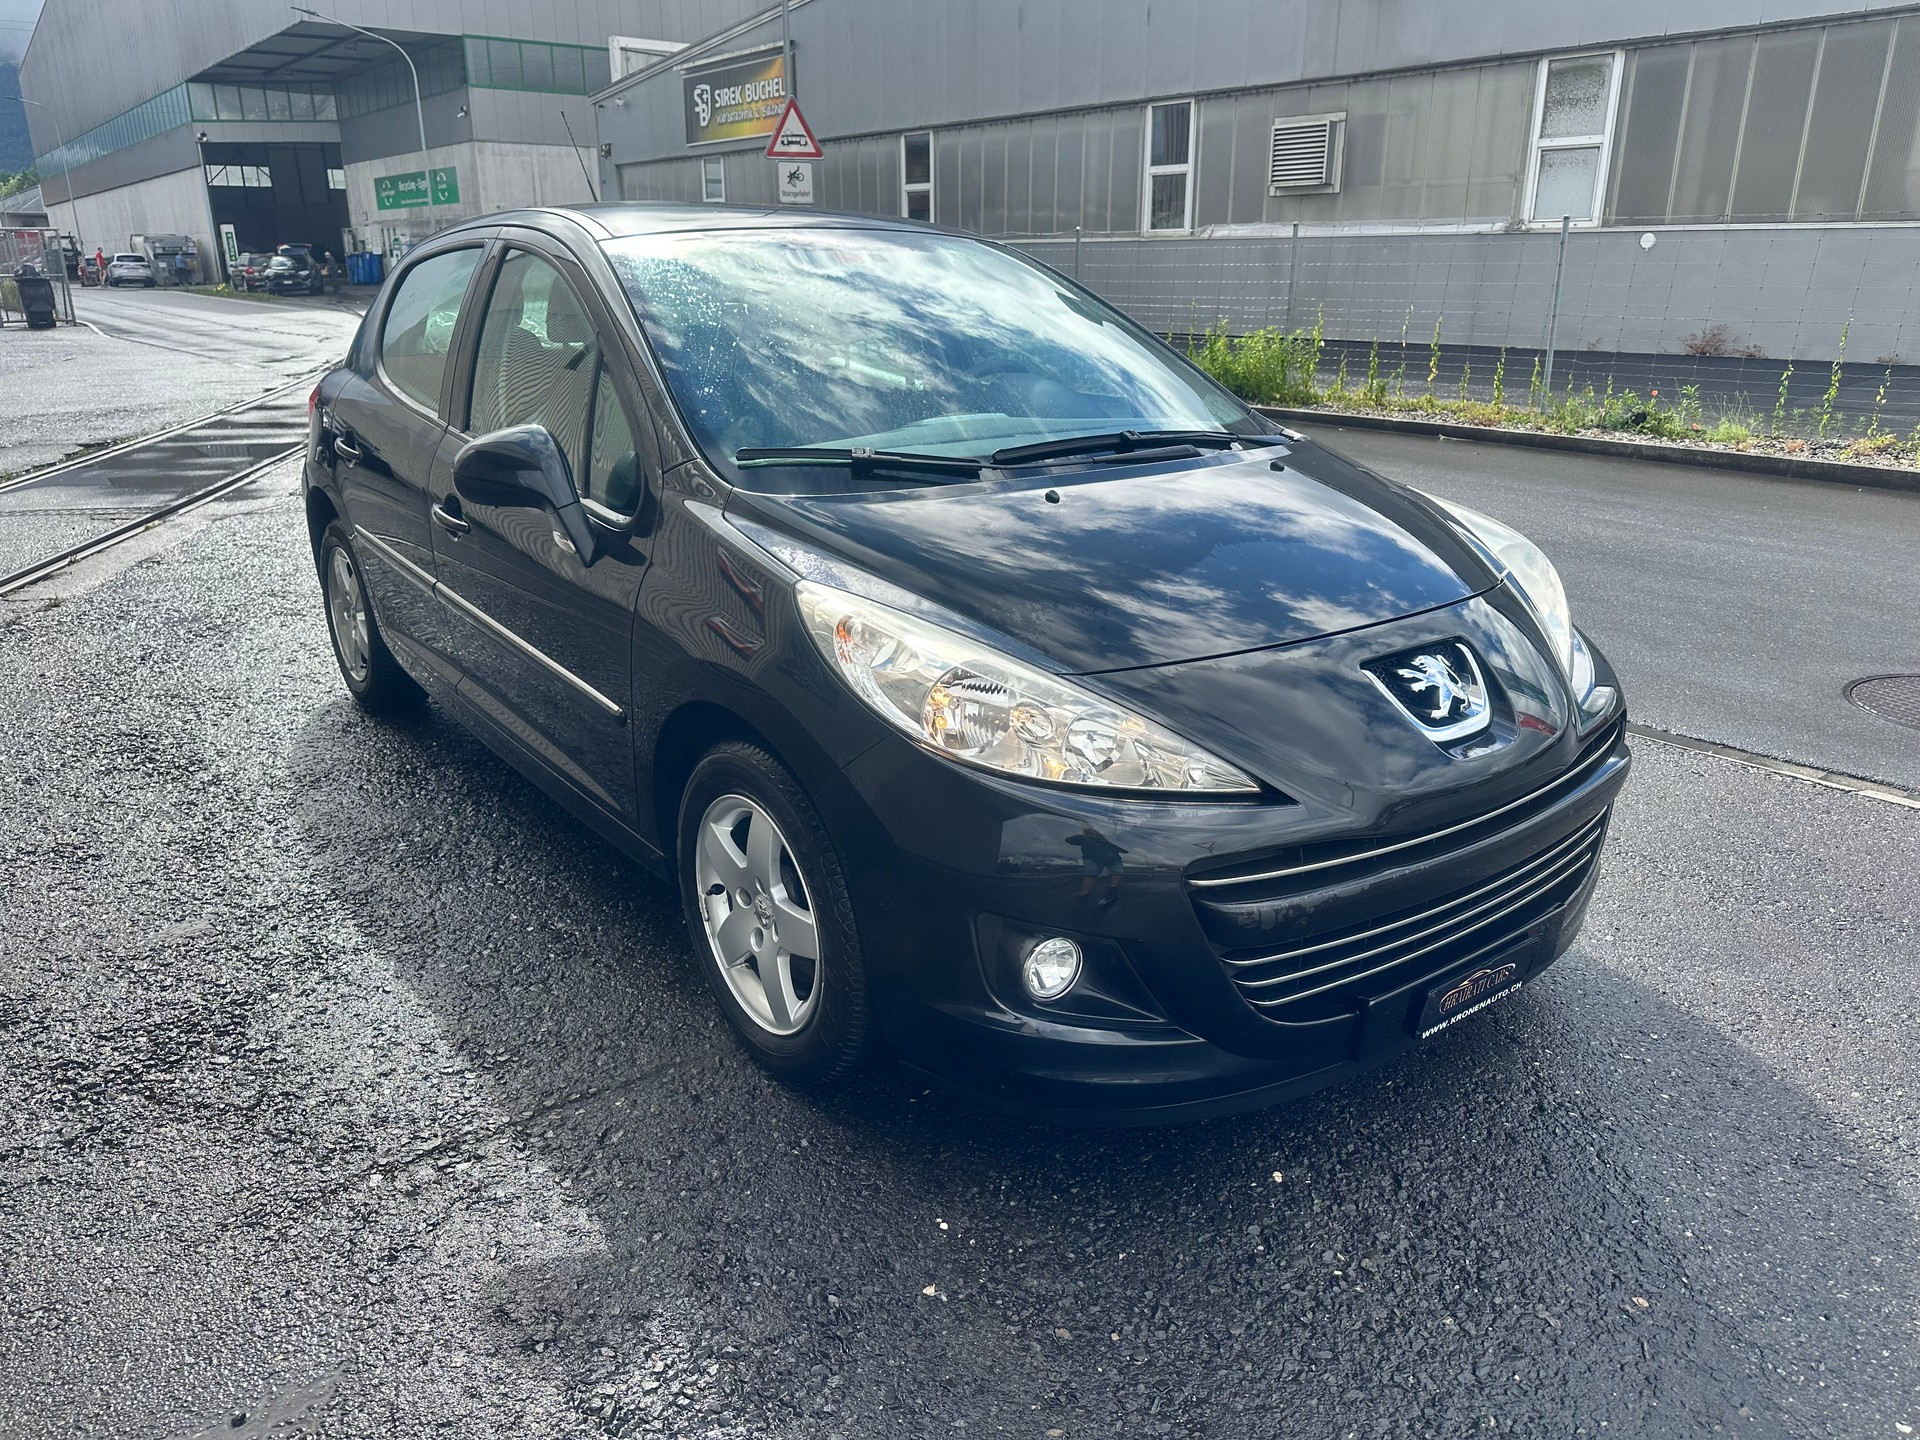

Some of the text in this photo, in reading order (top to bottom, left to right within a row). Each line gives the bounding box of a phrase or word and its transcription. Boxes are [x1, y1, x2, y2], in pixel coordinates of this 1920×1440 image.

[714, 85, 743, 108] SIREK
[1487, 968, 1510, 989] CARS
[1422, 981, 1523, 1040] WWW.KRONENAUTO.CH
